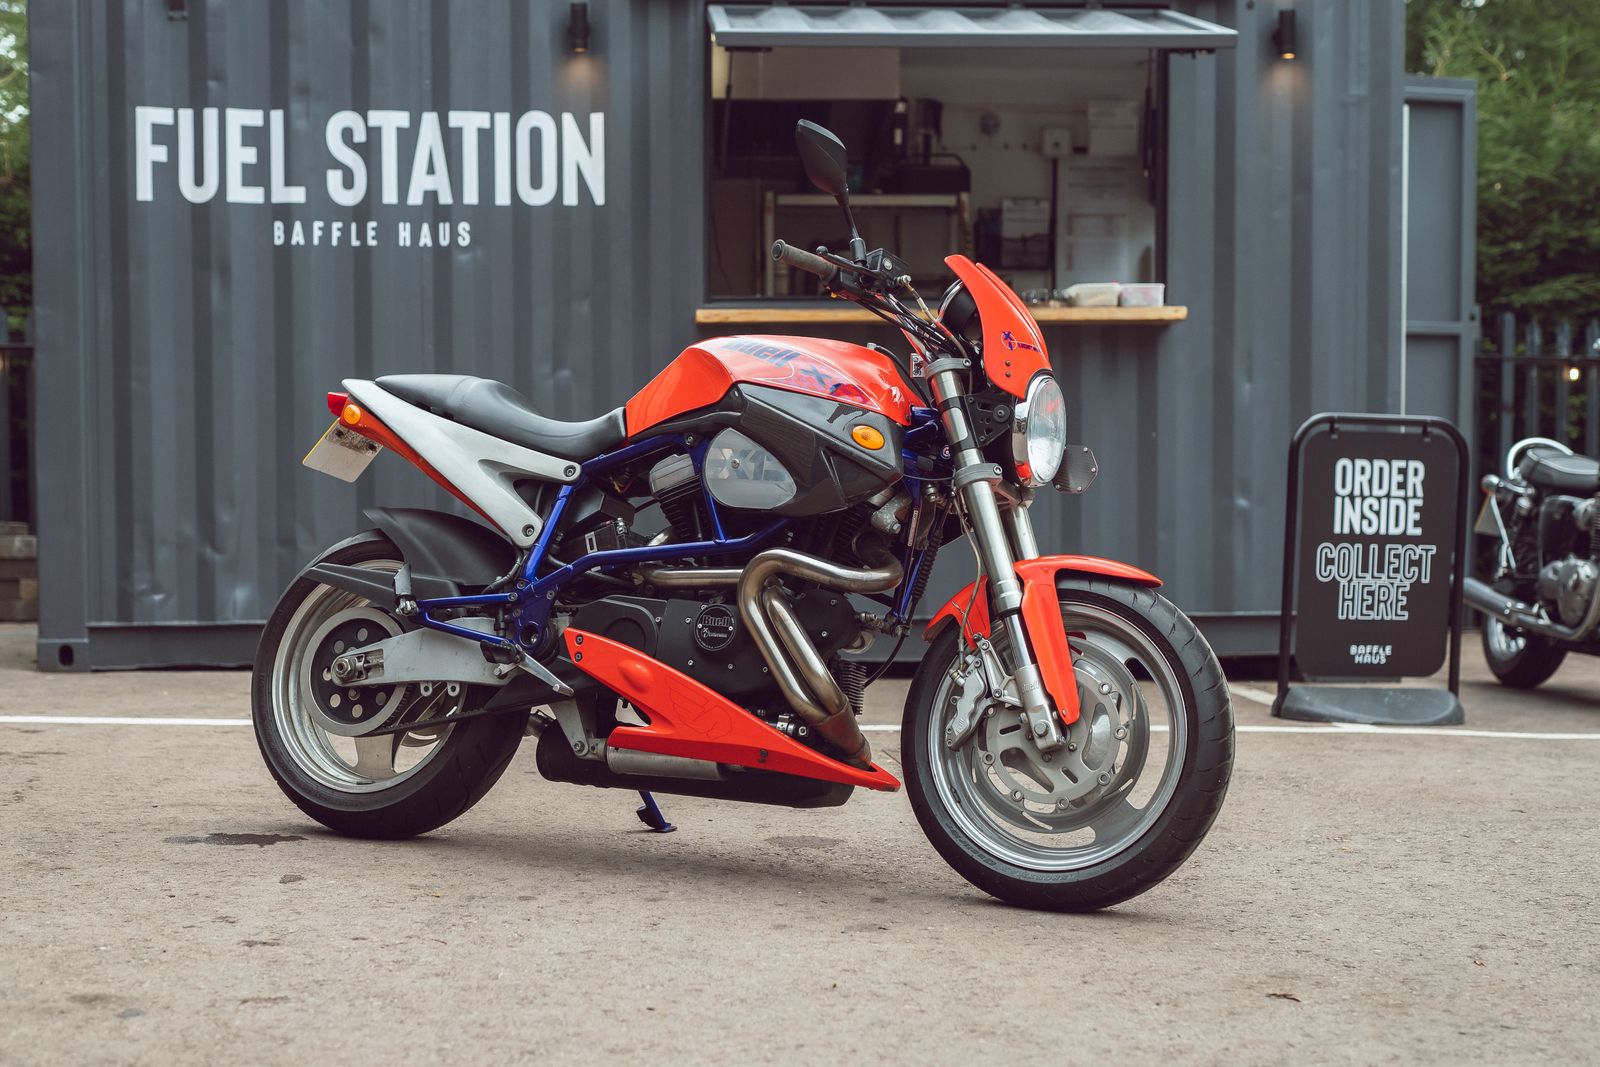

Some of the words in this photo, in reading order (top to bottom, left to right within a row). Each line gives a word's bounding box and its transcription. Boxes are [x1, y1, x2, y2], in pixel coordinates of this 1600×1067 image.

[135, 106, 306, 204] FUEL
[325, 109, 606, 207] STATION
[273, 220, 379, 247] BAFFLE
[398, 221, 472, 247] HAUS
[1334, 457, 1426, 499] ORDER
[1333, 496, 1424, 536] INSIDE
[1315, 541, 1437, 584] COLLECT
[1337, 581, 1410, 621] HERE
[702, 615, 730, 628] Buell
[1350, 644, 1392, 656] BAFFLE
[1354, 653, 1387, 664] HAUS
